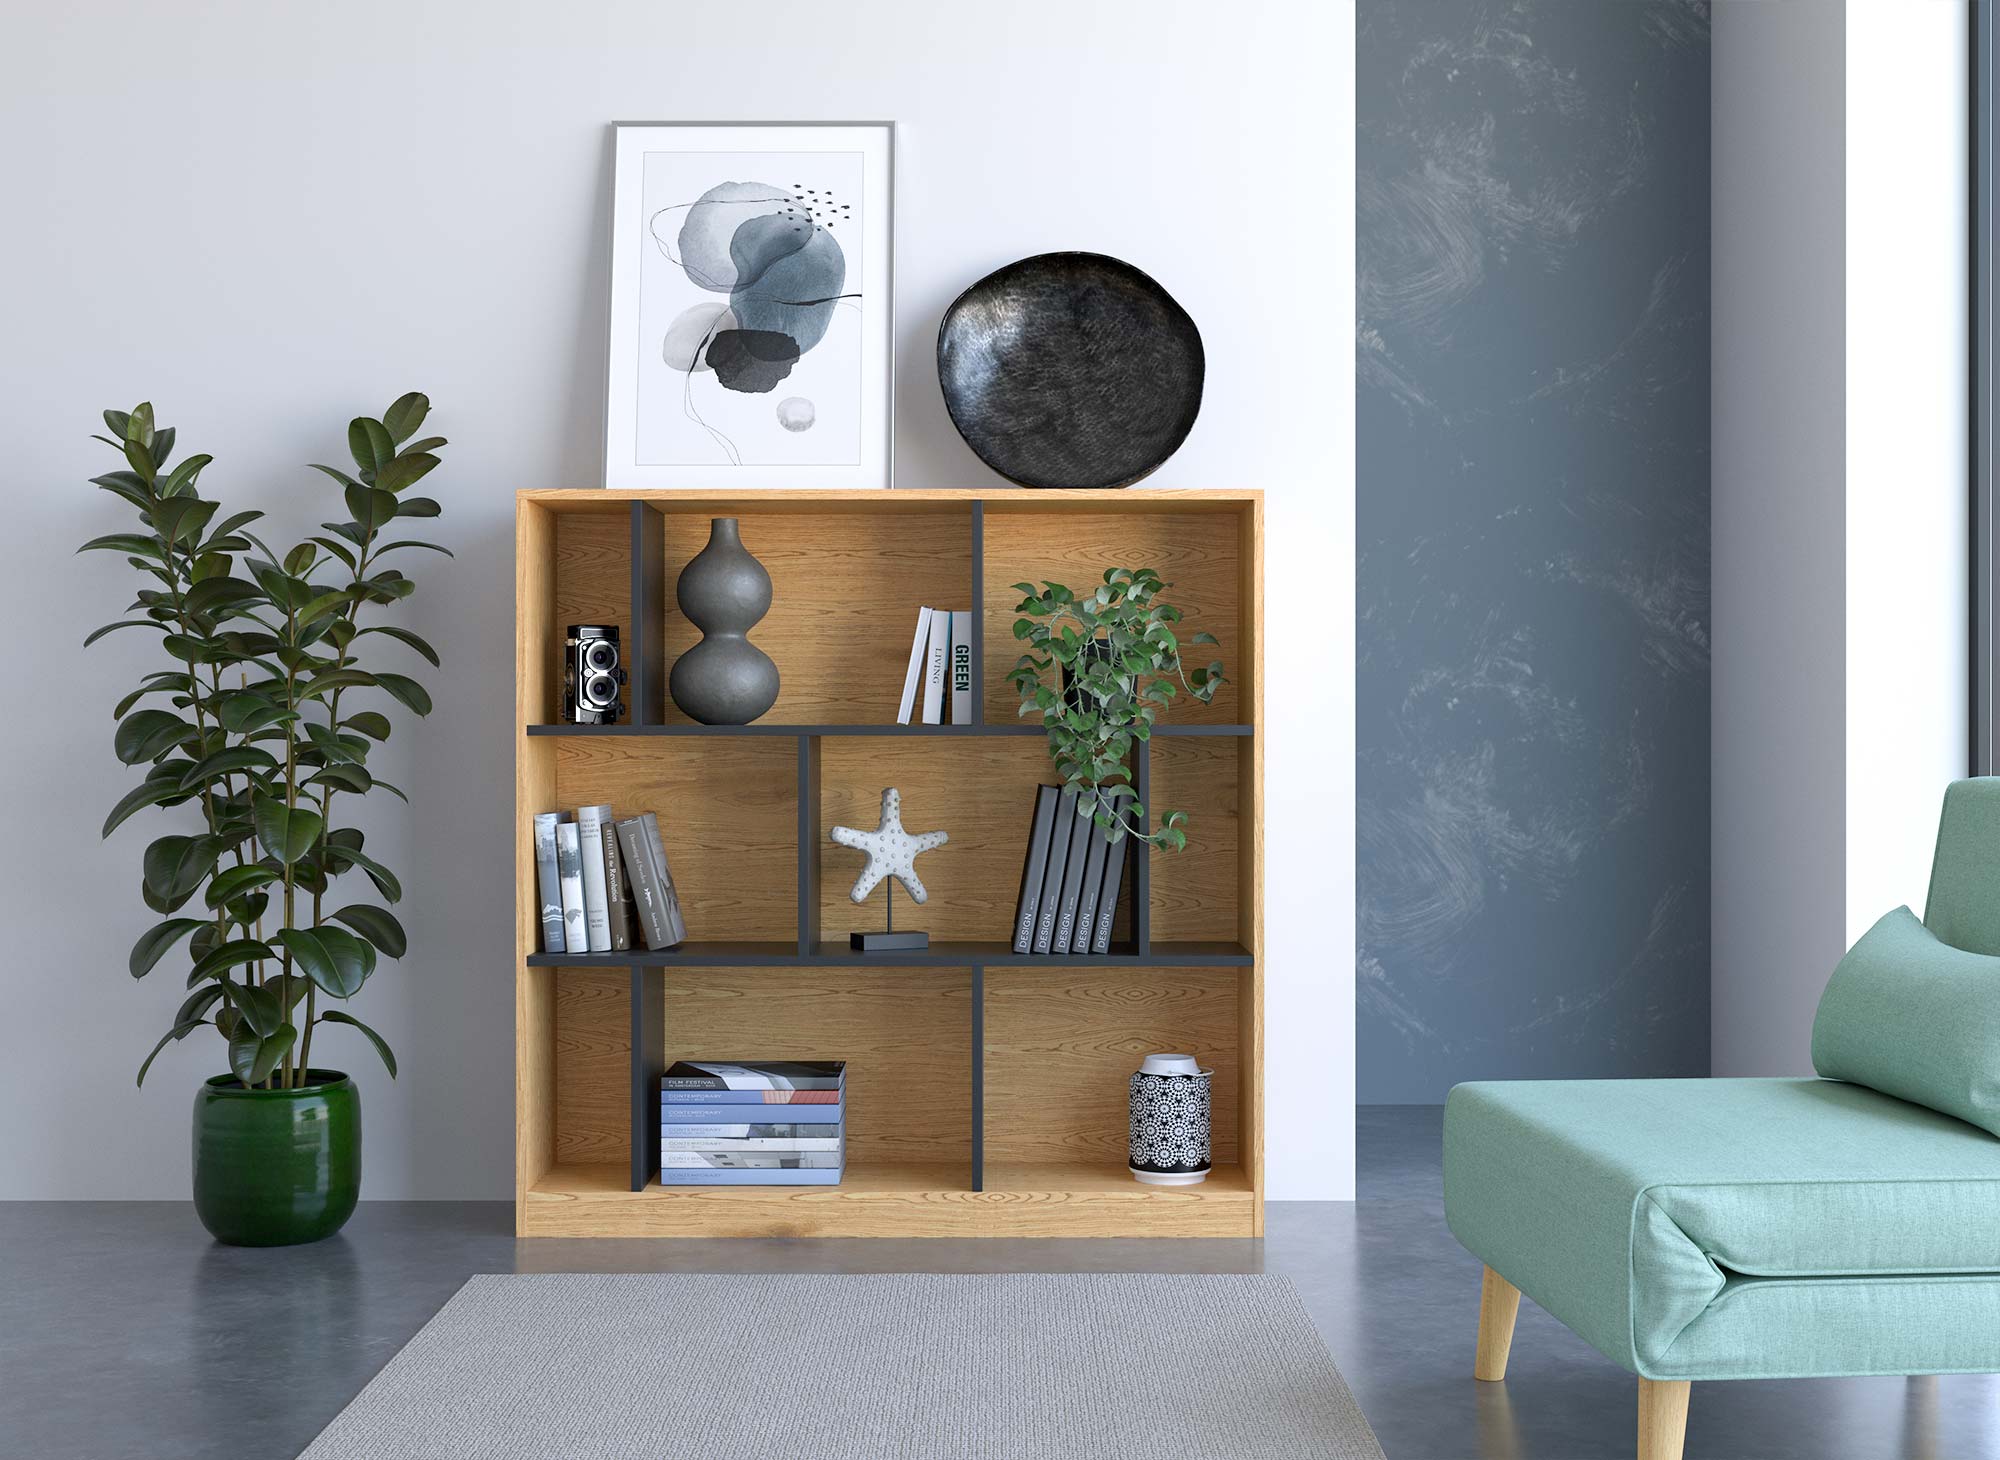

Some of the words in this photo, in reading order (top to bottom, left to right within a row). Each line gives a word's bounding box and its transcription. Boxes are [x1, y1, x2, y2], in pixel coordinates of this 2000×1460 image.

[933, 648, 942, 684] LIVING
[955, 644, 970, 691] GREEN
[609, 867, 618, 902] Revolution
[1019, 913, 1032, 948] DESIGN
[1039, 913, 1051, 948] DESIGN
[1058, 913, 1071, 948] DESIGN
[1078, 913, 1091, 948] DESIGN
[1098, 913, 1110, 948] DESIGN
